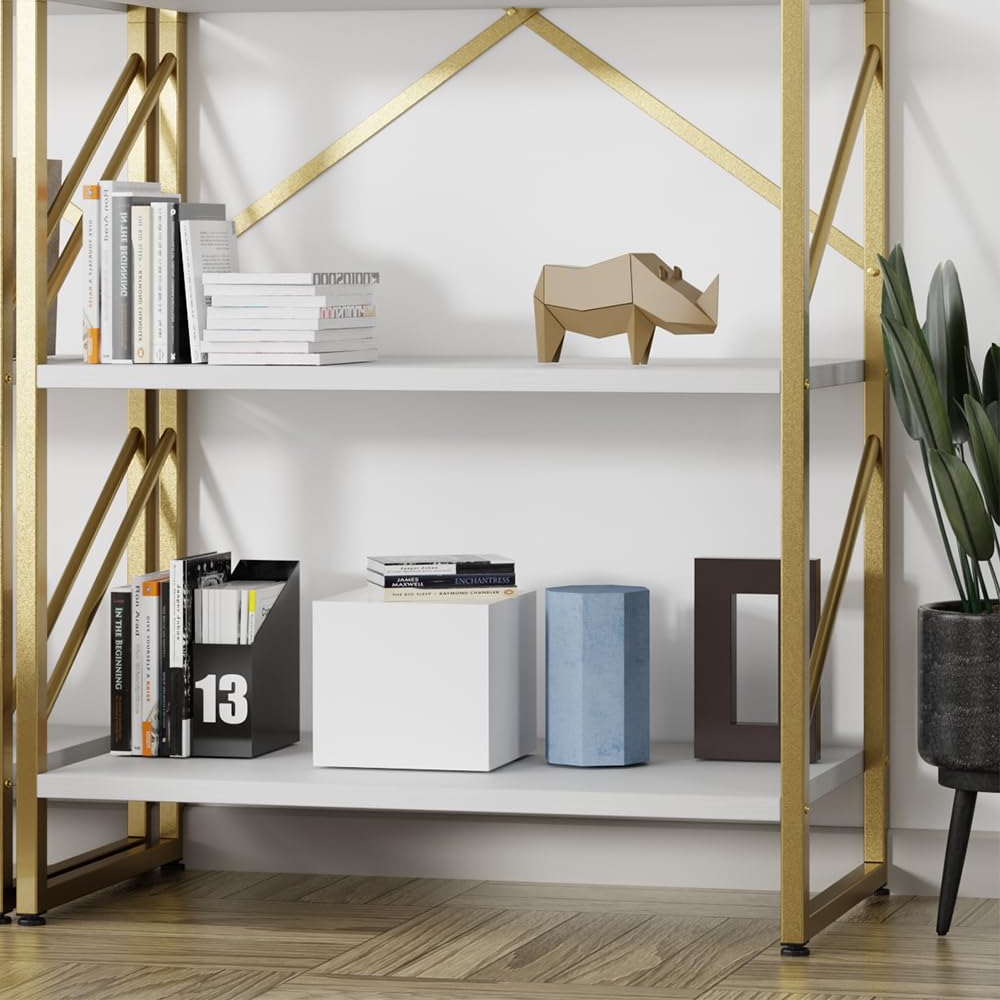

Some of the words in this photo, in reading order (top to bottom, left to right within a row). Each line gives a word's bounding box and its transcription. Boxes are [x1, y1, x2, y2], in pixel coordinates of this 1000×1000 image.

[455, 577, 511, 585] ENCHANTRESS
[115, 639, 123, 690] BEGINNING
[195, 674, 248, 725] 13
